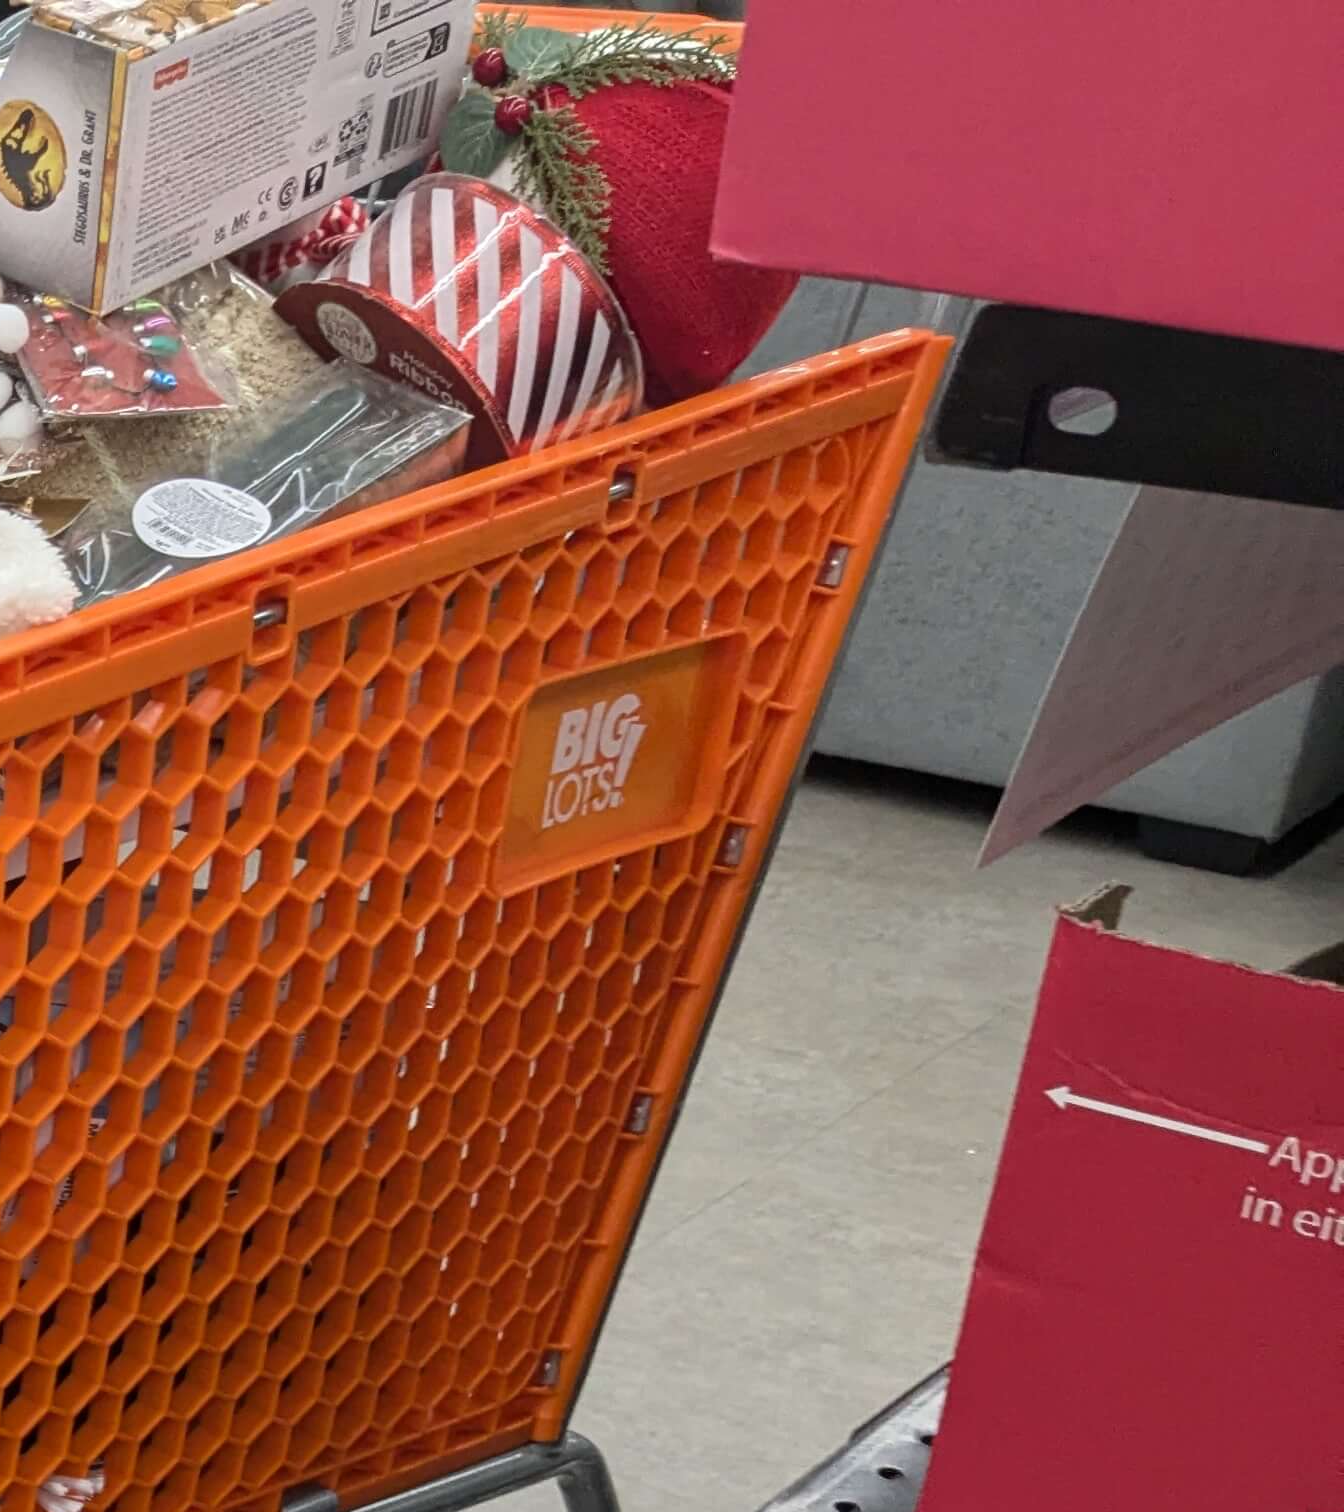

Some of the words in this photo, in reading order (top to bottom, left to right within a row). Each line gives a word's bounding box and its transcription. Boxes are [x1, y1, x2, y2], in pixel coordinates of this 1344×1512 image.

[72, 180, 91, 246] STEGOSAURUS
[82, 109, 97, 145] GRANT
[550, 692, 641, 776] BIG
[1240, 1186, 1284, 1228] in
